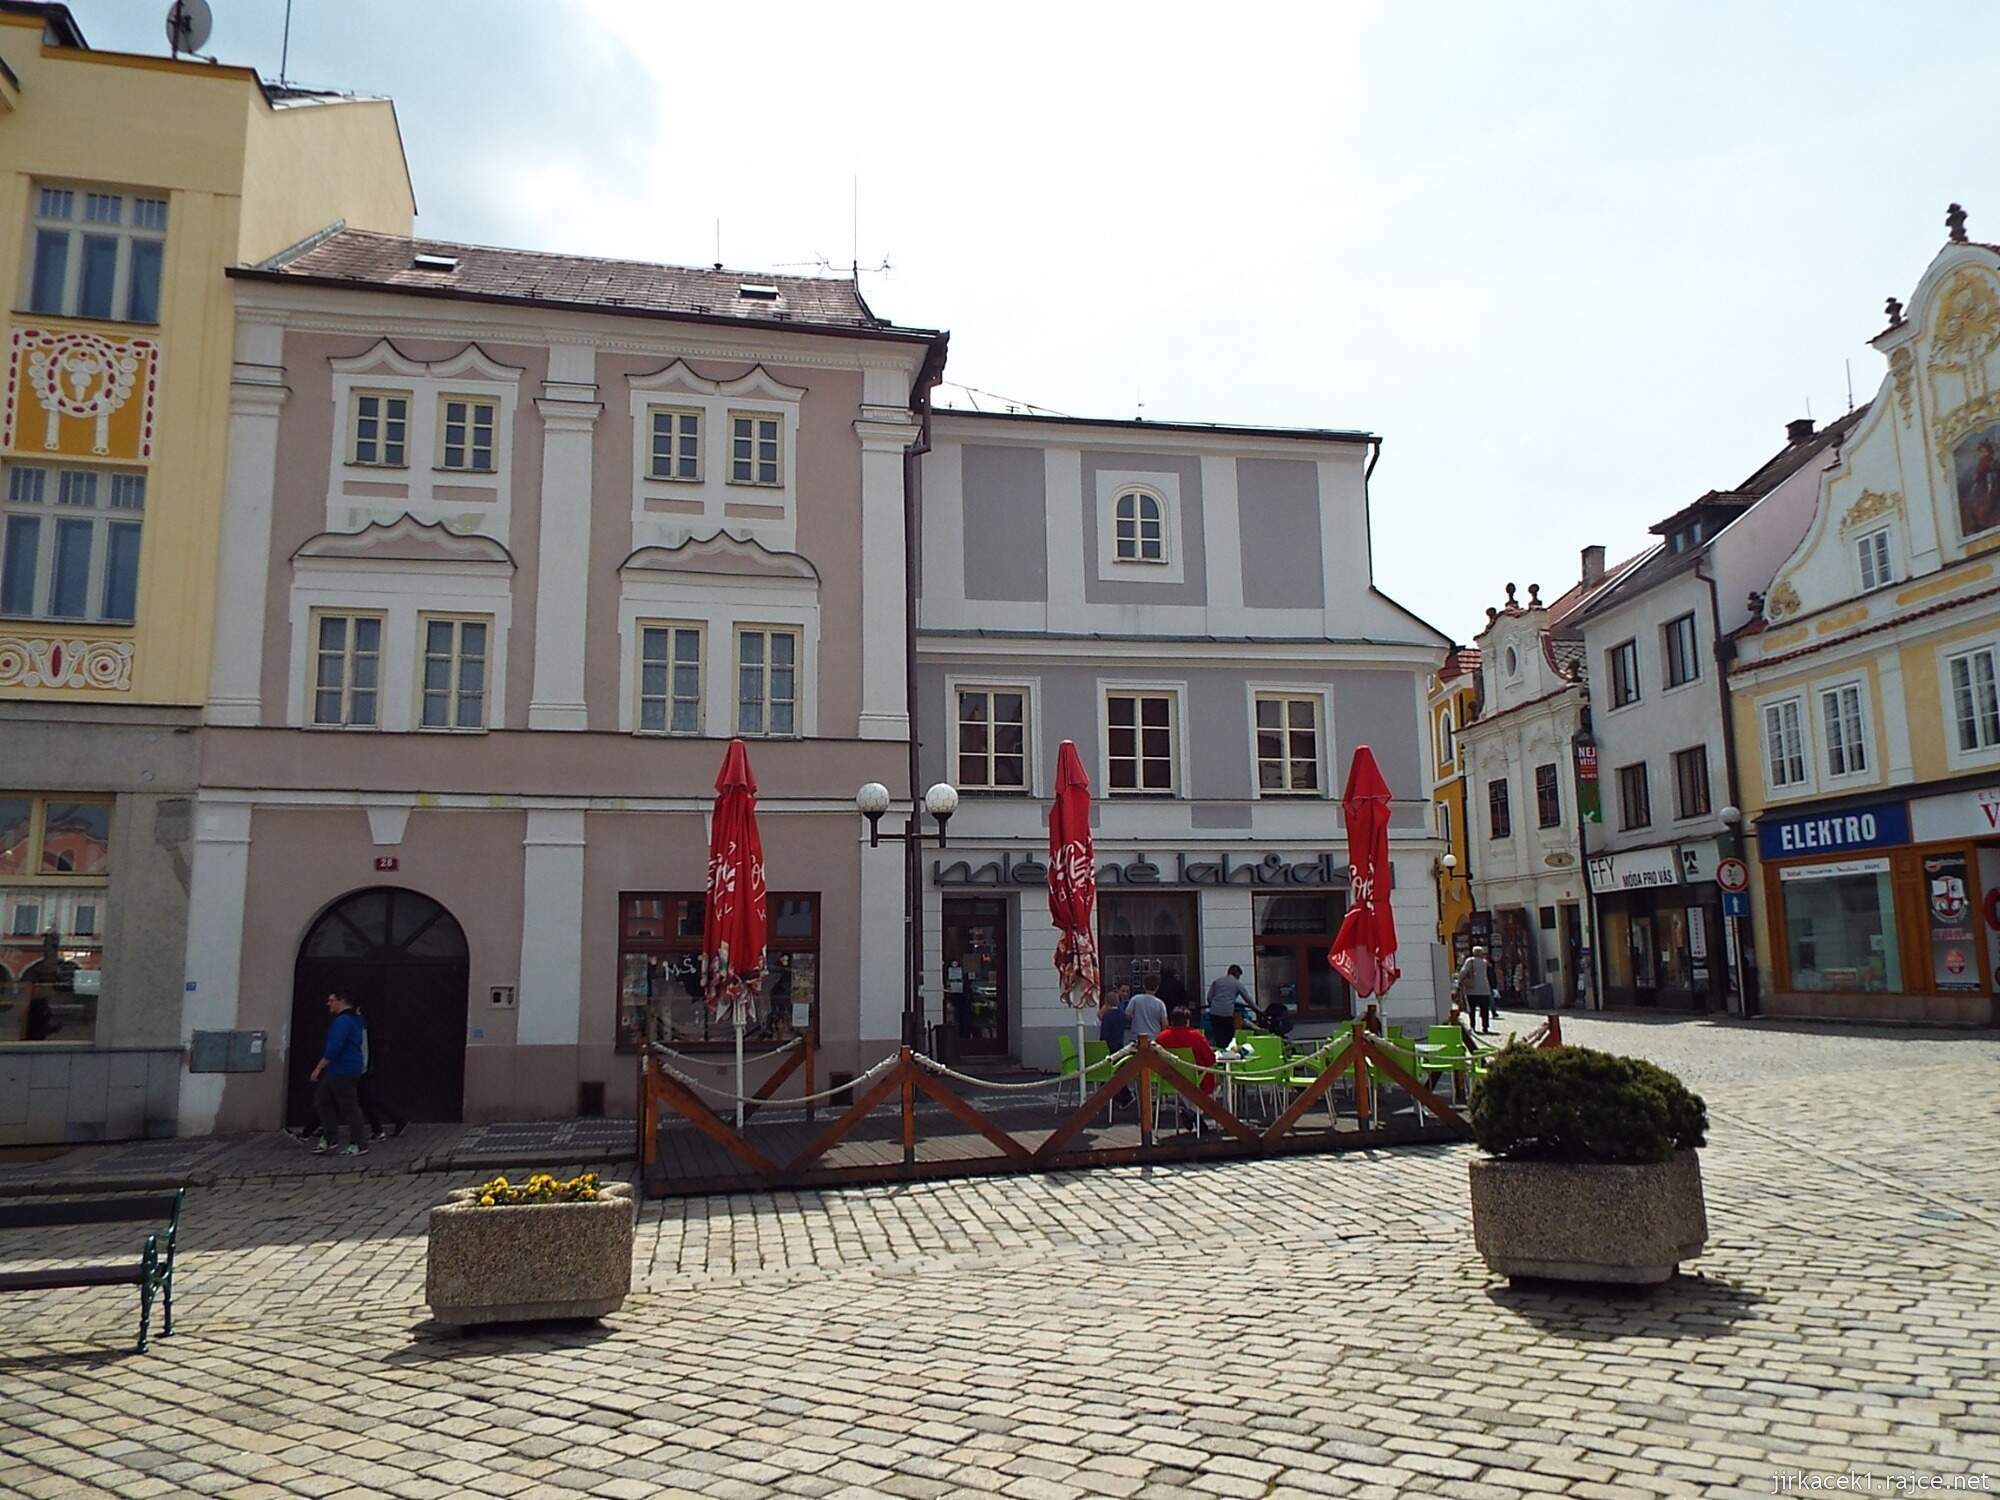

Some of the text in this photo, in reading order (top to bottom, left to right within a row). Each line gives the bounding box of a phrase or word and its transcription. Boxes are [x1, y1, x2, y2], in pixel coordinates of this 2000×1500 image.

[1781, 813, 1877, 850] ELEKTRO
[934, 852, 1159, 885] mléné
[1642, 870, 1658, 886] PRO
[1657, 866, 1673, 884] VÁS
